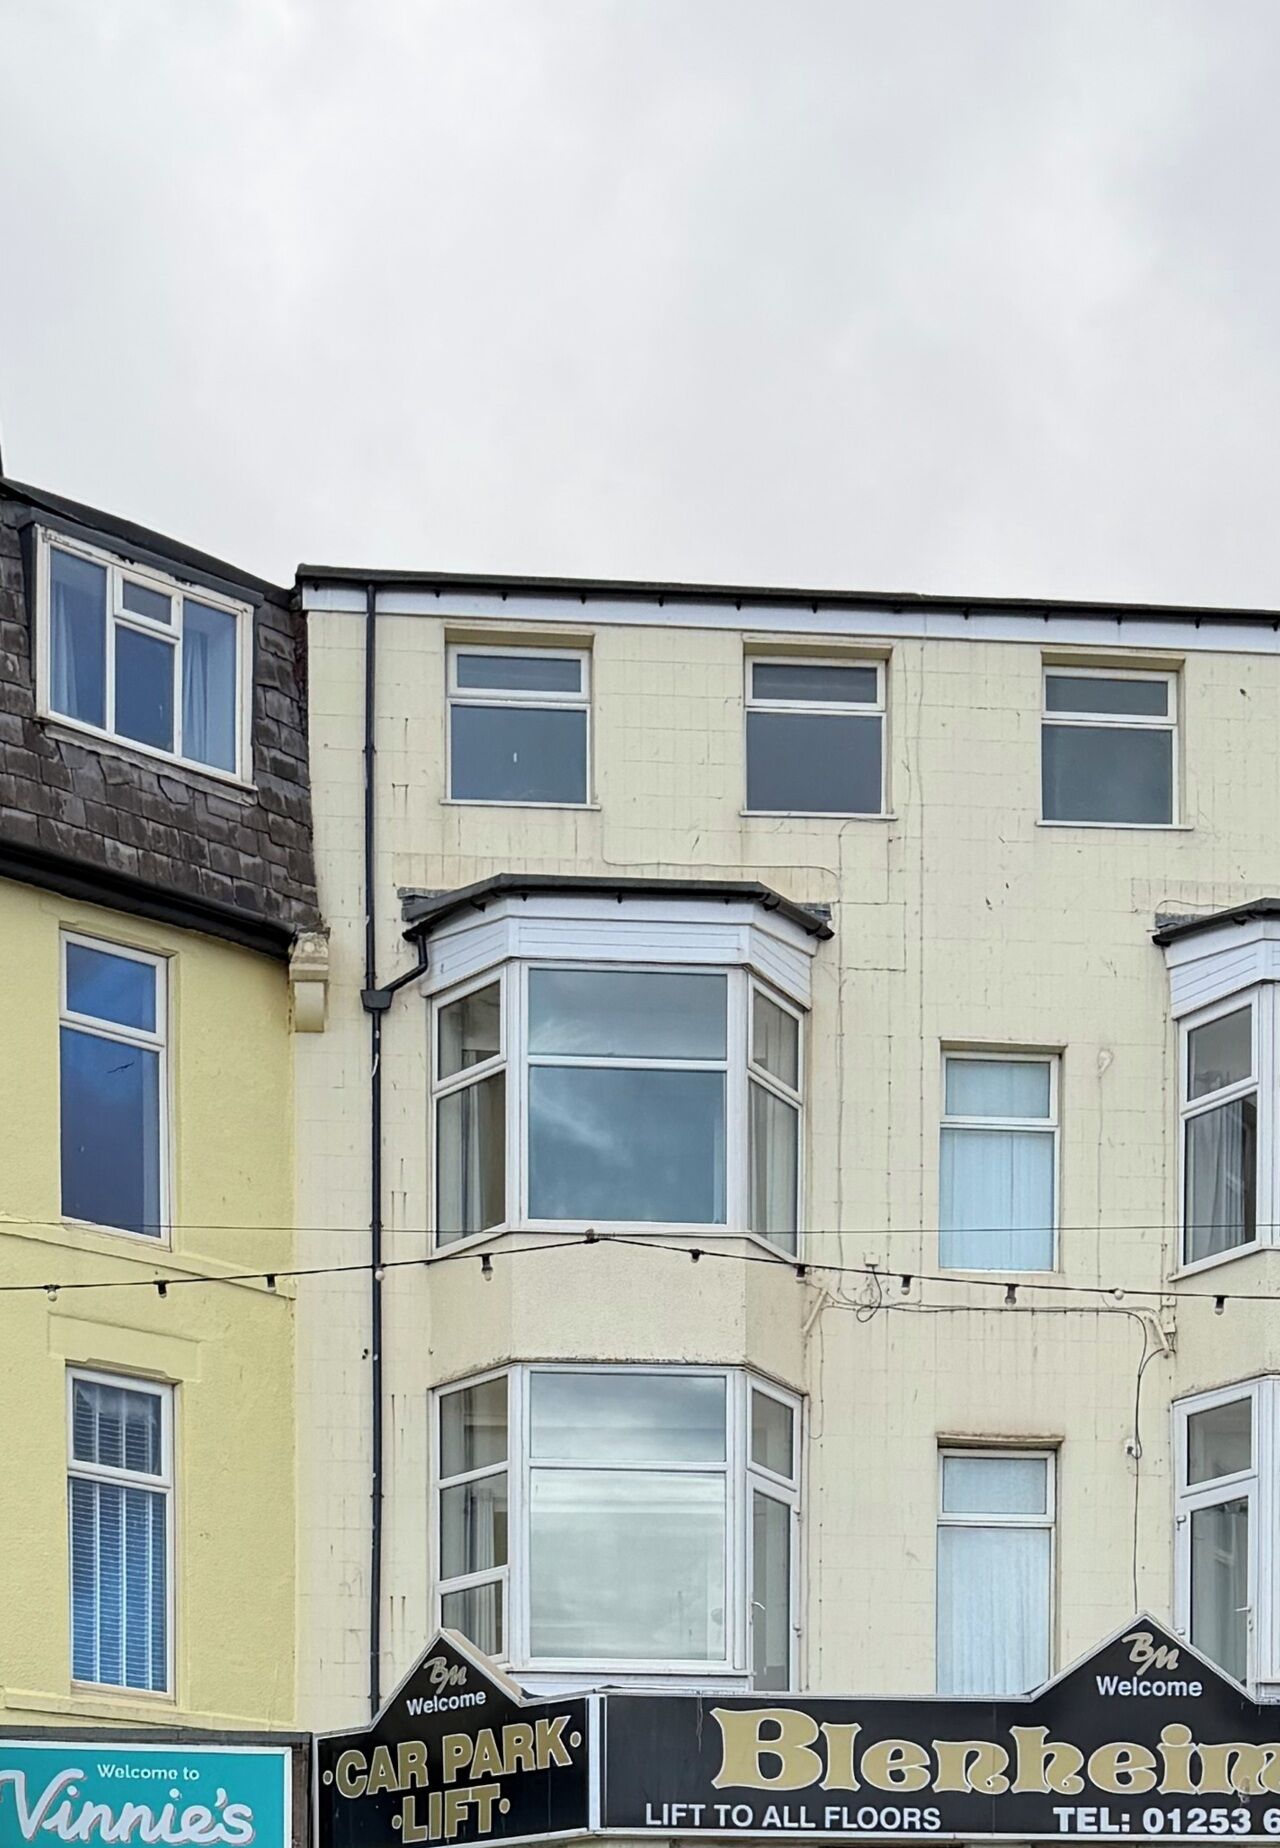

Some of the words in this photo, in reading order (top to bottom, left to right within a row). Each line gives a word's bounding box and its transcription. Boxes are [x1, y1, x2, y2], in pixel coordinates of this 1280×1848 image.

[1096, 1675, 1203, 1697] Welcome
[406, 1690, 487, 1716] Welcome
[335, 1740, 430, 1799] CAR
[442, 1715, 573, 1784] PARK
[97, 1763, 178, 1781] Welcome
[183, 1765, 200, 1781] to
[402, 1783, 501, 1844] LIFT
[645, 1803, 707, 1829] LIFT
[713, 1803, 756, 1830] TO
[760, 1804, 817, 1830] ALL
[824, 1805, 942, 1832] FLOORS
[1053, 1806, 1131, 1833] TEL:
[1141, 1807, 1252, 1835] 01253
